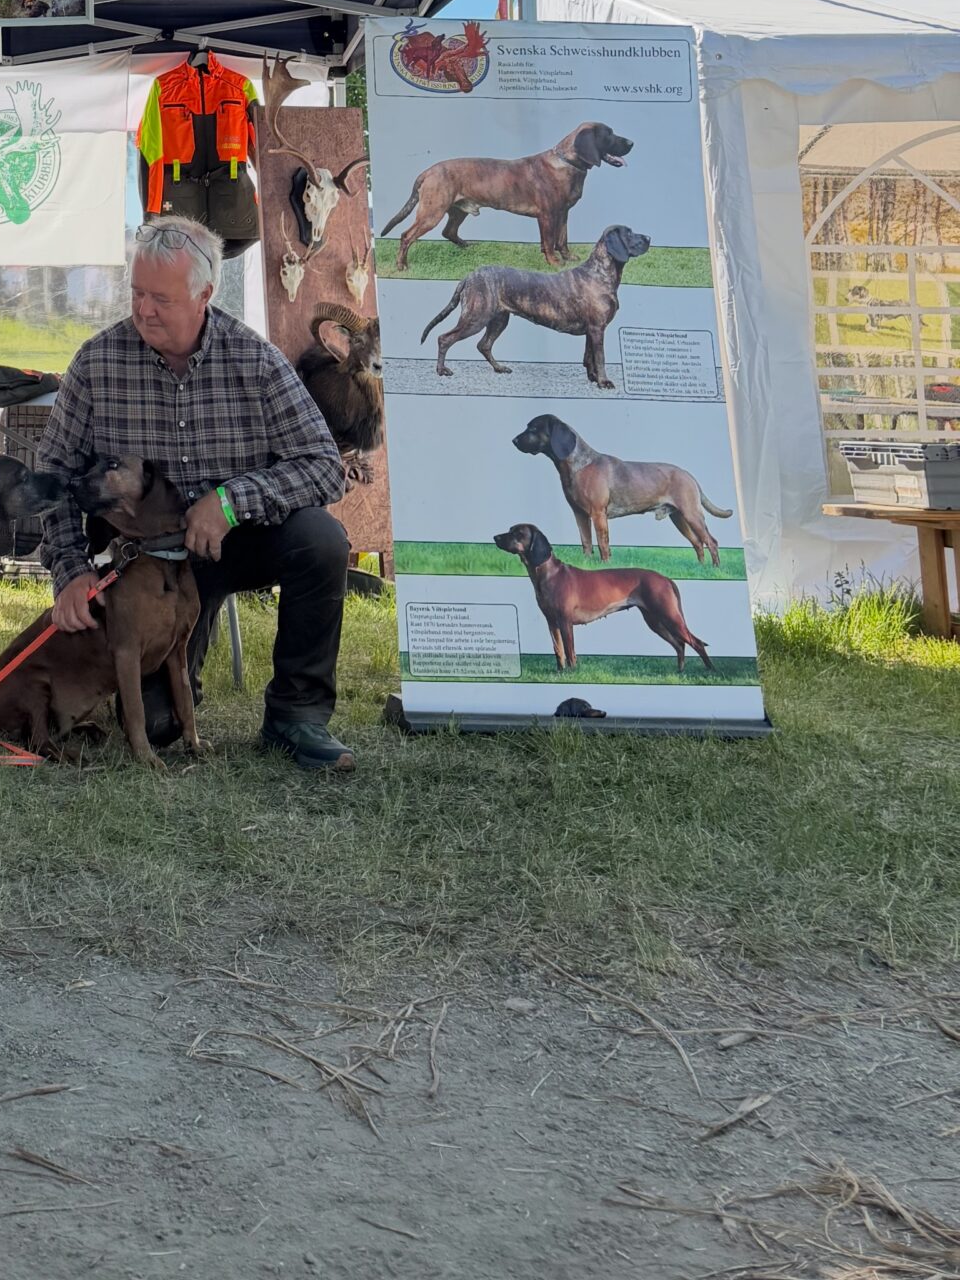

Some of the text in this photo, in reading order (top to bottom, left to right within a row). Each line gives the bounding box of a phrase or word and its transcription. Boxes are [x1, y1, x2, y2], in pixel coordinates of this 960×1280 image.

[497, 44, 681, 58] Svenska Schweisshundklubben
[604, 83, 683, 96] www.svshk.org
[24, 150, 53, 202] KLUBBEN
